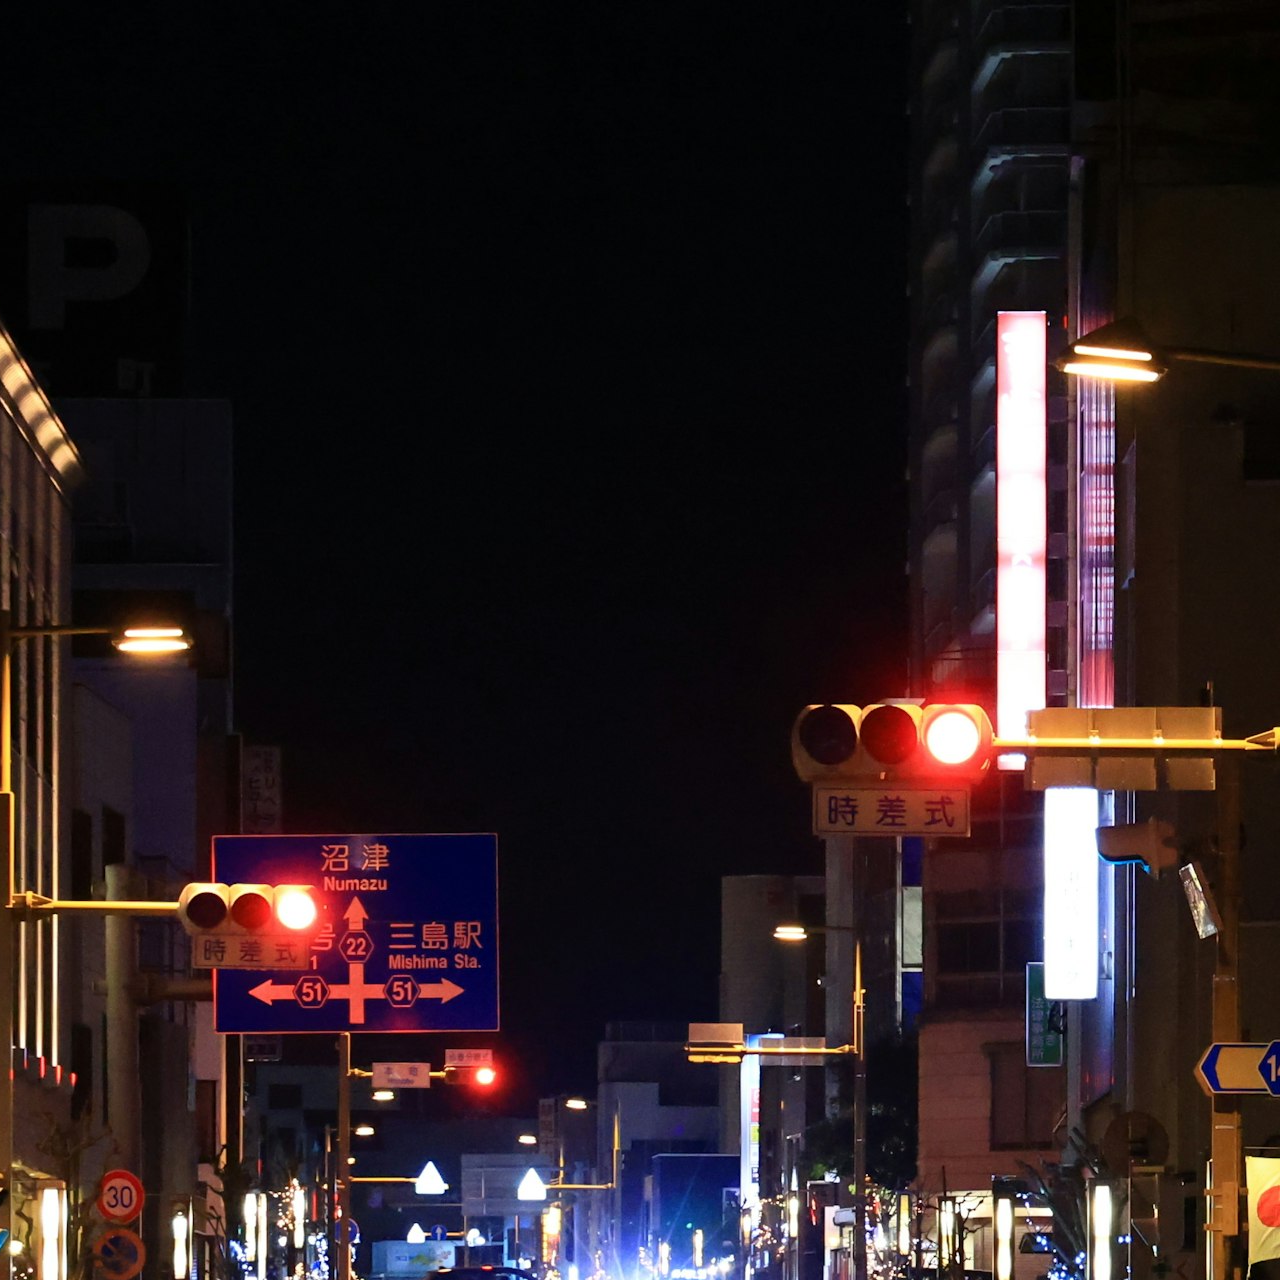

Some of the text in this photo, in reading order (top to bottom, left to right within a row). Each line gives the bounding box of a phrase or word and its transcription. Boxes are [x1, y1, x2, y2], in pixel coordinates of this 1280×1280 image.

[26, 203, 152, 331] P
[828, 796, 954, 828] 時差式
[321, 843, 391, 872] 沼津
[323, 876, 388, 892] Numazu
[388, 921, 484, 951] 三島駅
[204, 941, 298, 963] 時差式
[346, 938, 367, 957] 22
[388, 955, 482, 970] Mishima Sta.
[301, 982, 323, 1001] 51
[393, 982, 414, 1001] 51
[106, 1186, 133, 1208] 30
